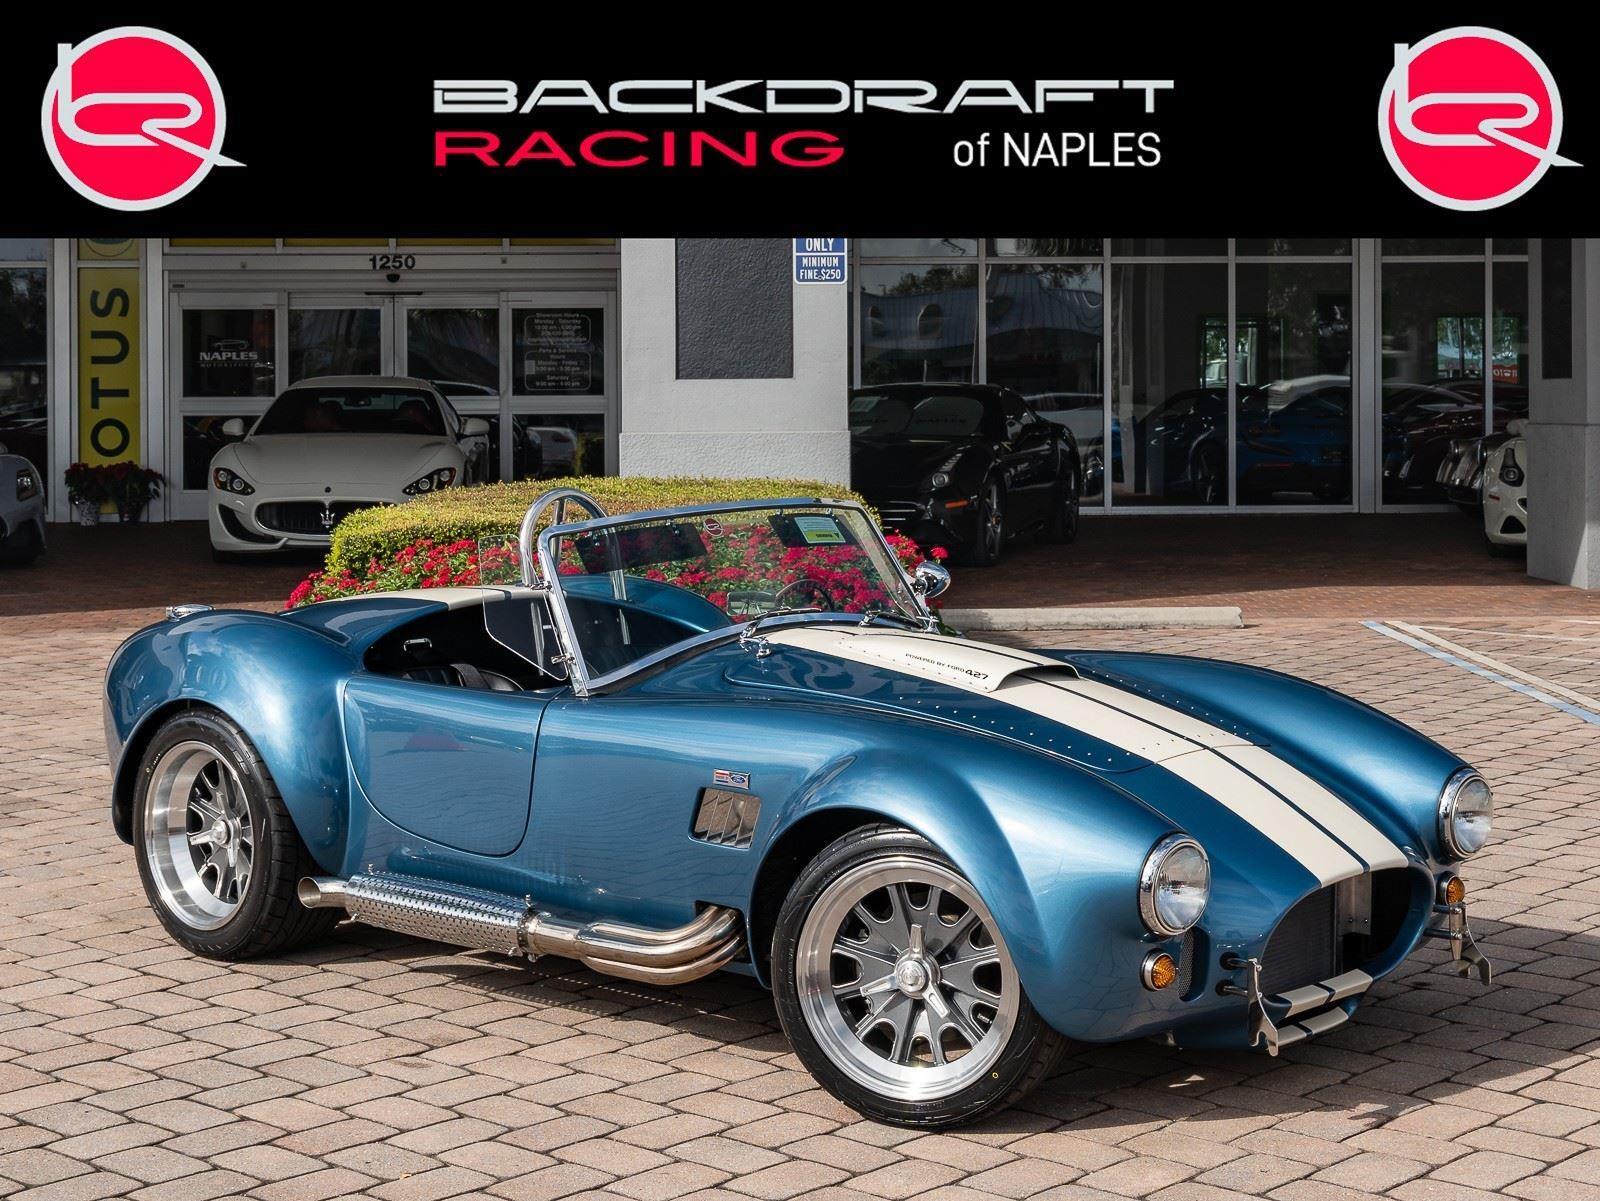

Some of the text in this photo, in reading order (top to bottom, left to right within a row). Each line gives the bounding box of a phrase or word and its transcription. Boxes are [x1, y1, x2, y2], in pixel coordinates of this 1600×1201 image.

[805, 238, 834, 251] ONLY
[369, 254, 416, 270] 1250
[802, 256, 839, 267] MINIMUM
[800, 268, 841, 280] FINE $250
[200, 351, 258, 360] NAPLES
[90, 288, 130, 457] OTUS
[965, 669, 989, 680] 427
